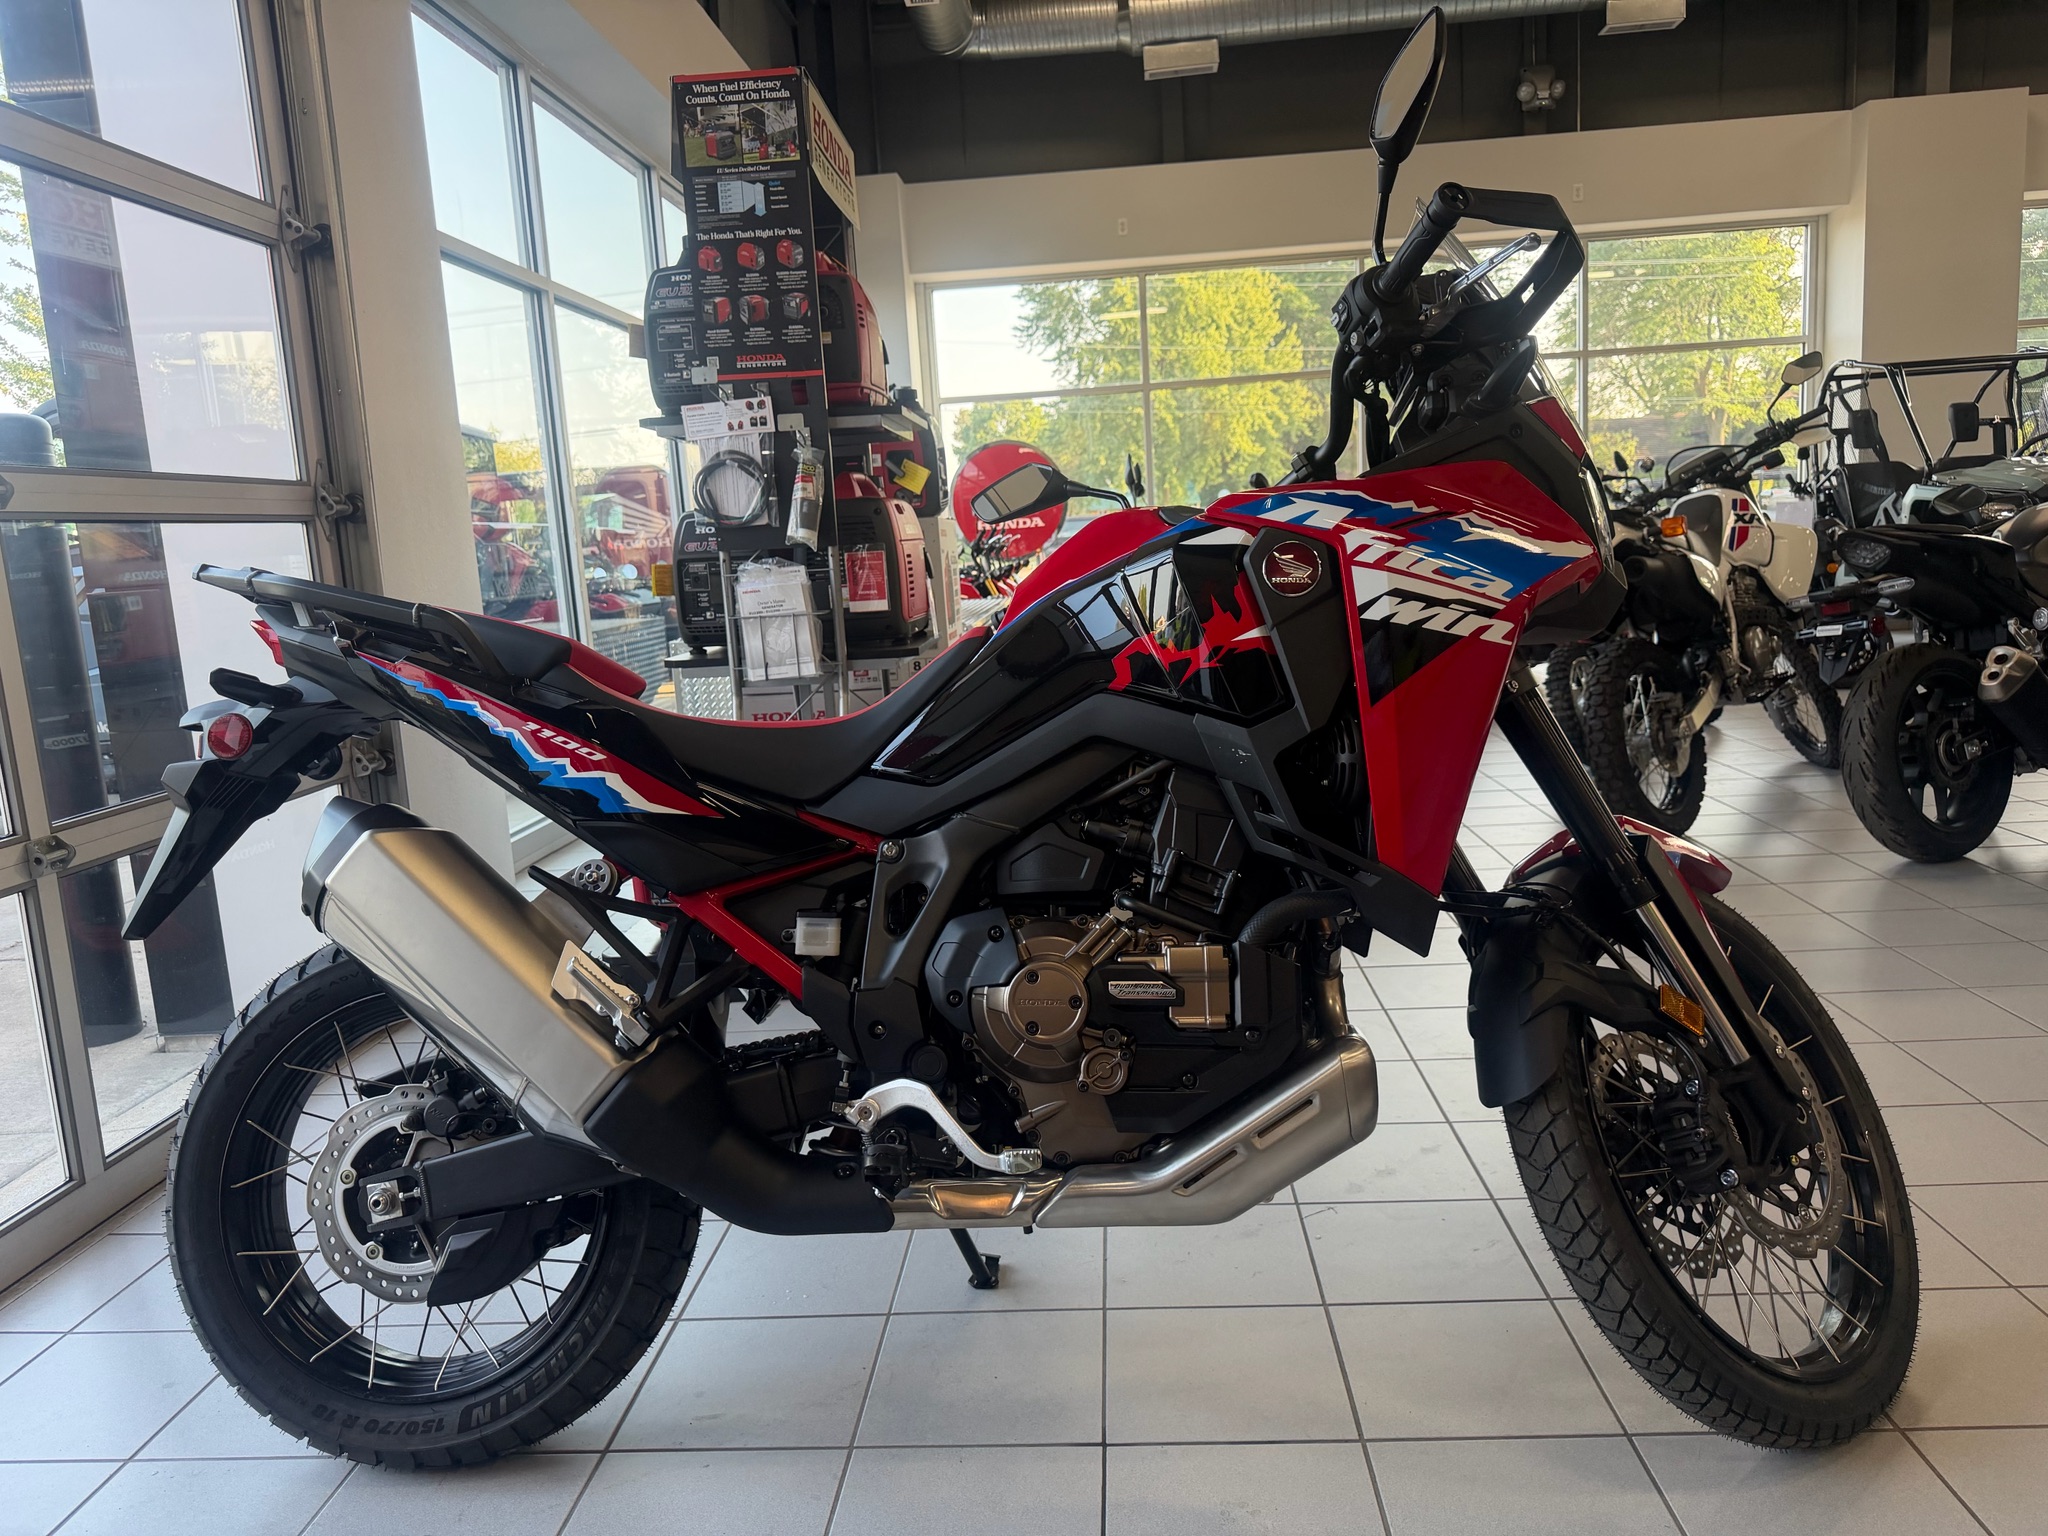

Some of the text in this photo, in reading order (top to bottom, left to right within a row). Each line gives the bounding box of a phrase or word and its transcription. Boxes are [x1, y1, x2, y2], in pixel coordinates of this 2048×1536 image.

[686, 89, 790, 104] Counts, Count On Honda
[692, 80, 781, 93] When Fuel Efficiency
[812, 101, 853, 190] HONDA
[814, 145, 855, 213] GENERATORS
[696, 227, 802, 241] The Honda That's Right For You.
[736, 353, 784, 362] HONDA
[1256, 496, 1515, 603] Africa
[753, 711, 825, 722] HONA
[521, 721, 606, 762] 1100
[1117, 989, 1173, 997] Transmission
[470, 1284, 611, 1428] MICHELIN
[311, 1403, 445, 1436] 150/70 R 18
